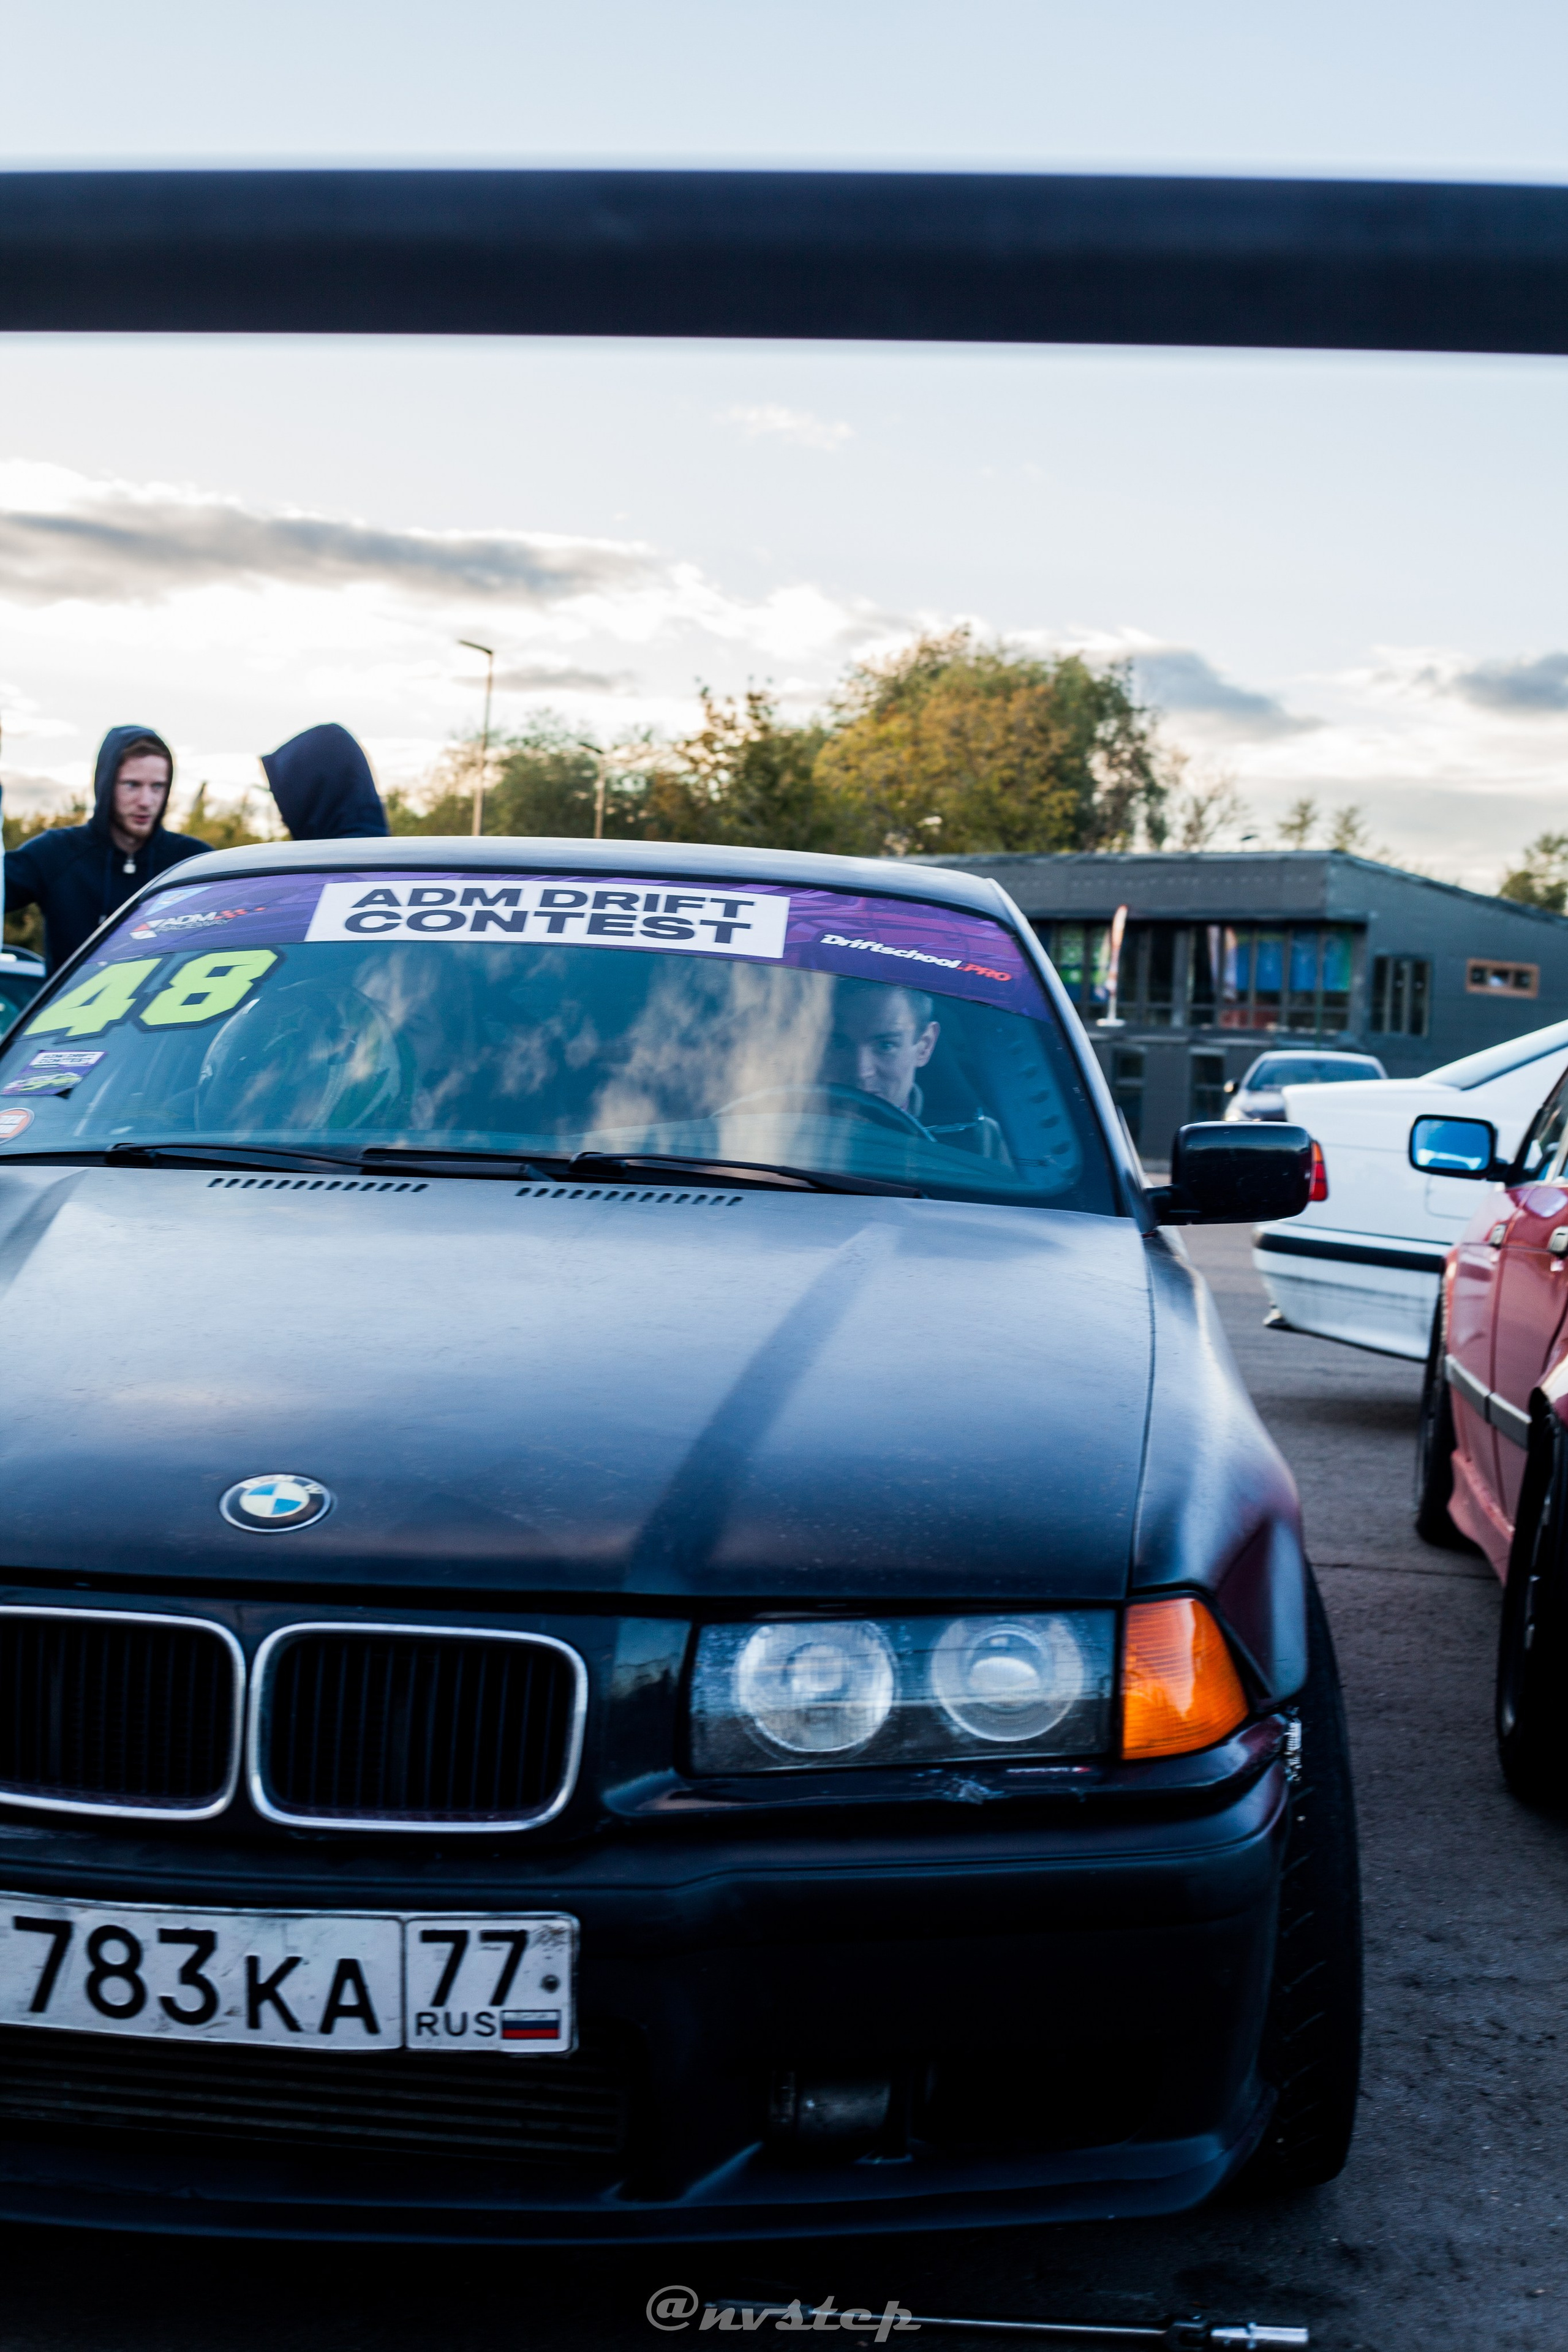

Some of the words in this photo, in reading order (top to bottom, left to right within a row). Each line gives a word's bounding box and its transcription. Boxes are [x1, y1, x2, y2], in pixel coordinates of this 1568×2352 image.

[351, 887, 522, 909] ADM
[540, 888, 756, 918] DRIFT
[162, 911, 217, 927] ADM
[344, 910, 752, 944] CONTEST
[21, 949, 280, 1038] 48
[420, 1929, 529, 2008] 77
[415, 2011, 497, 2037] RUS
